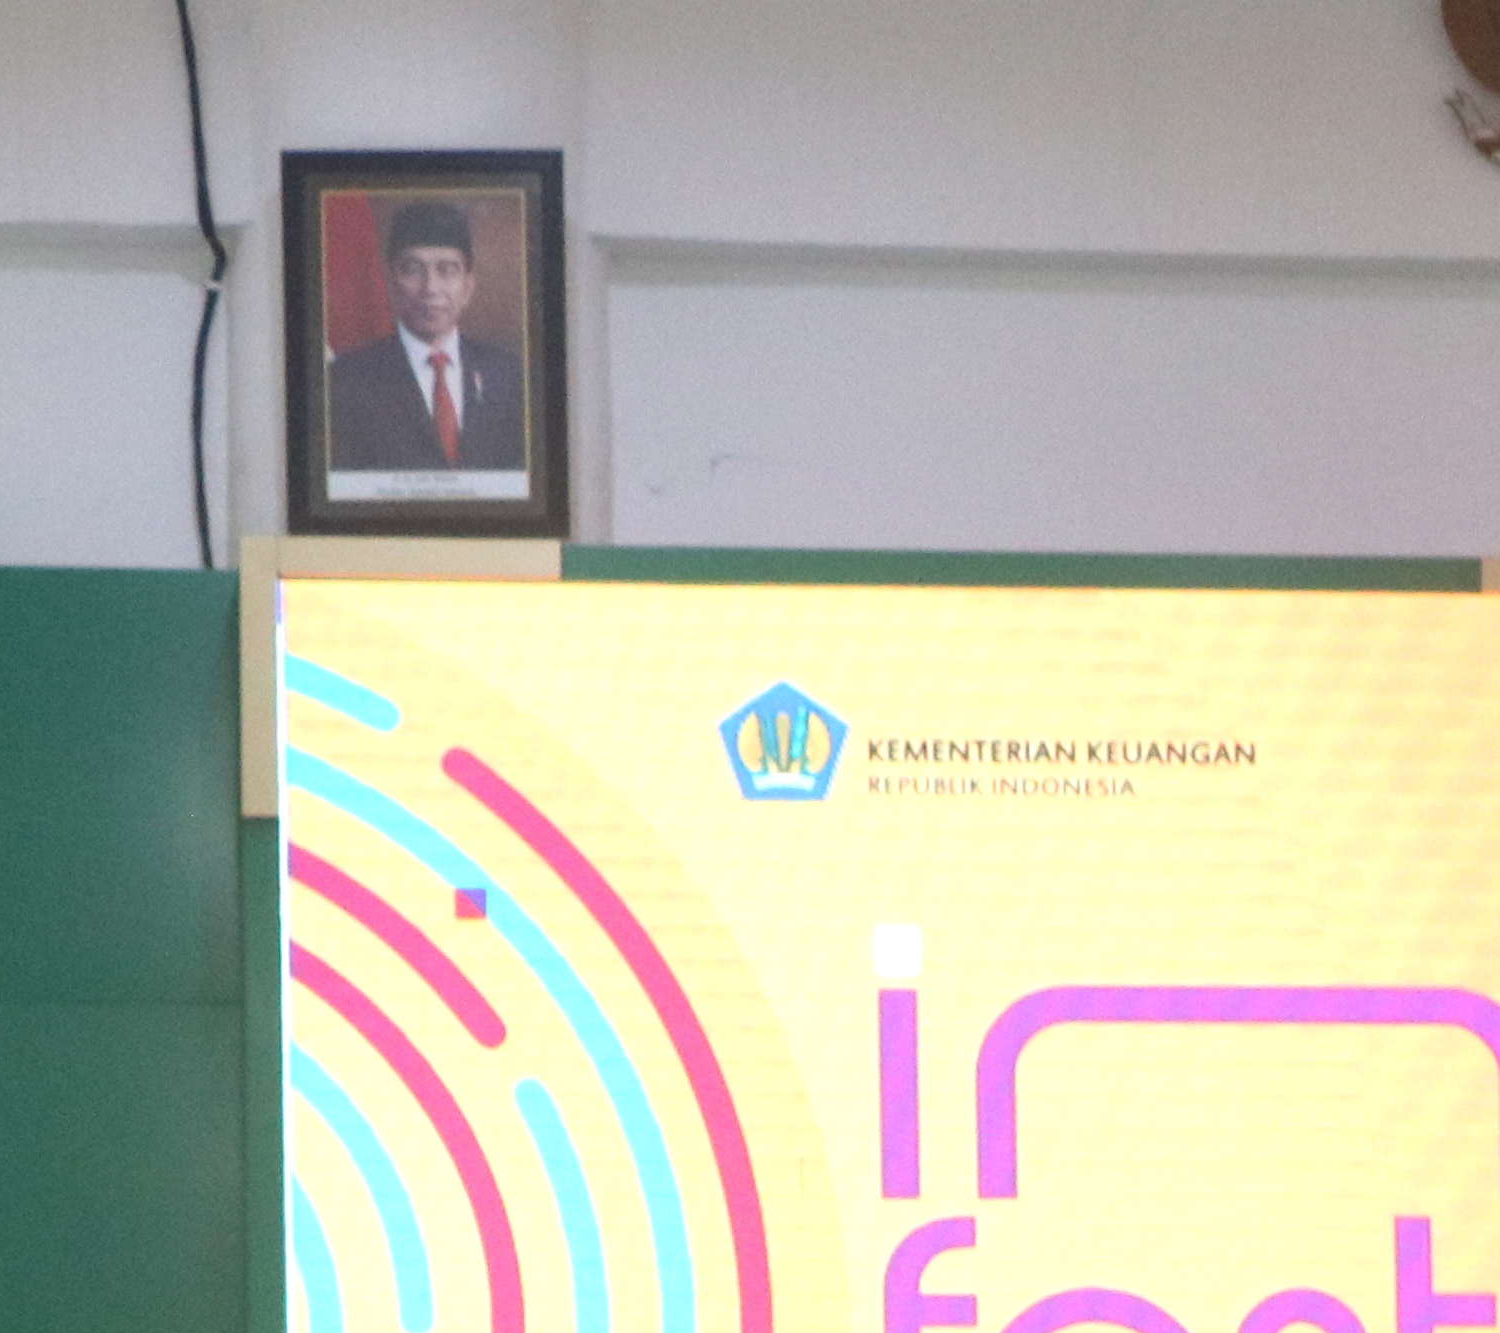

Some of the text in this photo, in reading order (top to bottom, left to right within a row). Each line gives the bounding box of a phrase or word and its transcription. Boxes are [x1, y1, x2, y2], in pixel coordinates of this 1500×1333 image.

[869, 740, 1255, 764] KEMENTERIAN KEUANGAN
[869, 778, 1134, 796] REPUBLIK INDONESIA
